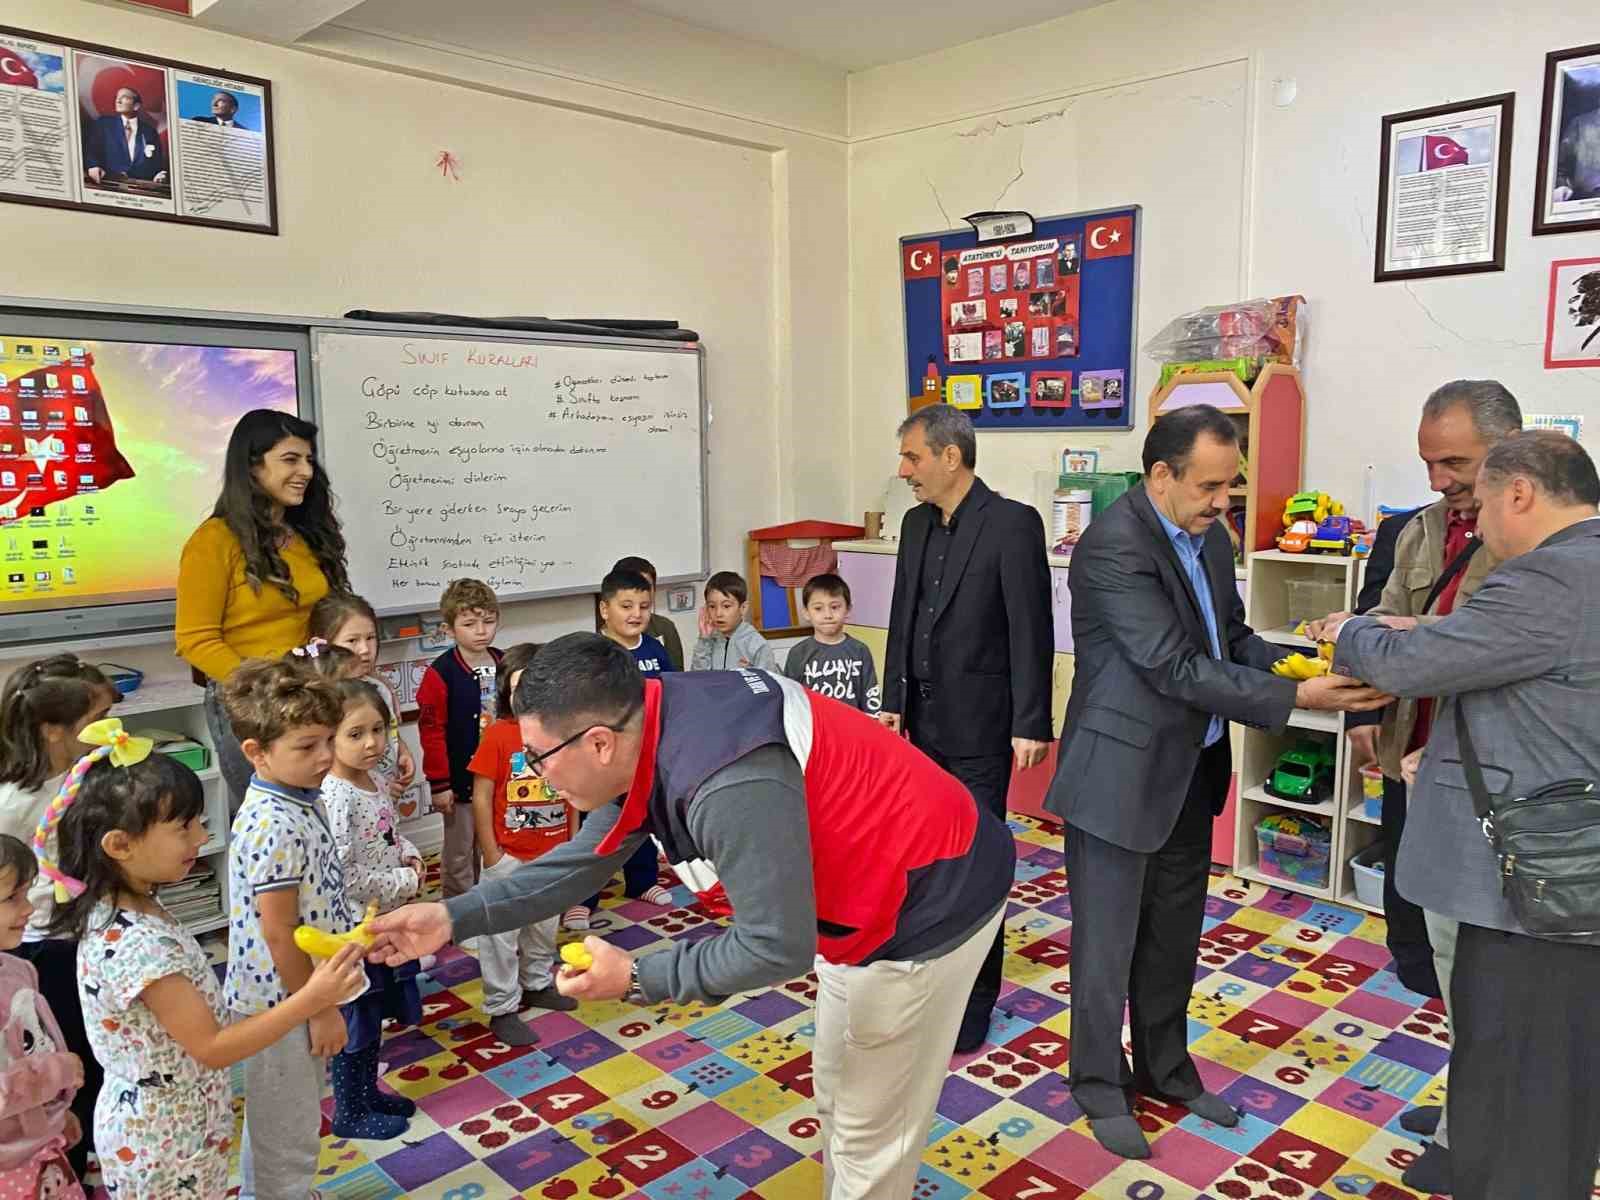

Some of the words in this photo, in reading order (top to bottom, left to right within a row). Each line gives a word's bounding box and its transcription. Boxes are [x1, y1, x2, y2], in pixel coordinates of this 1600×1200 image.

[1010, 242, 1055, 255] TANIYORUM
[804, 659, 862, 684] ALWAYS
[1223, 888, 1247, 899] 6
[1221, 932, 1250, 944] 4
[1040, 945, 1070, 958] 7
[1326, 962, 1357, 976] 2
[1217, 982, 1248, 996] 8
[618, 1021, 651, 1038] 6
[1247, 1018, 1280, 1034] 7
[1333, 1022, 1364, 1038] 0
[1029, 1042, 1063, 1057] 4
[1274, 1066, 1310, 1085] 6
[547, 1092, 585, 1110] 4
[1241, 1089, 1279, 1110] 3
[1343, 1092, 1380, 1111] 5
[788, 1117, 821, 1139] 6
[998, 1117, 1035, 1138] 8
[517, 1150, 552, 1170] 1
[624, 1144, 669, 1170] 2
[733, 1145, 773, 1168] 3
[1278, 1149, 1317, 1170] 4
[1015, 1176, 1057, 1200] 7
